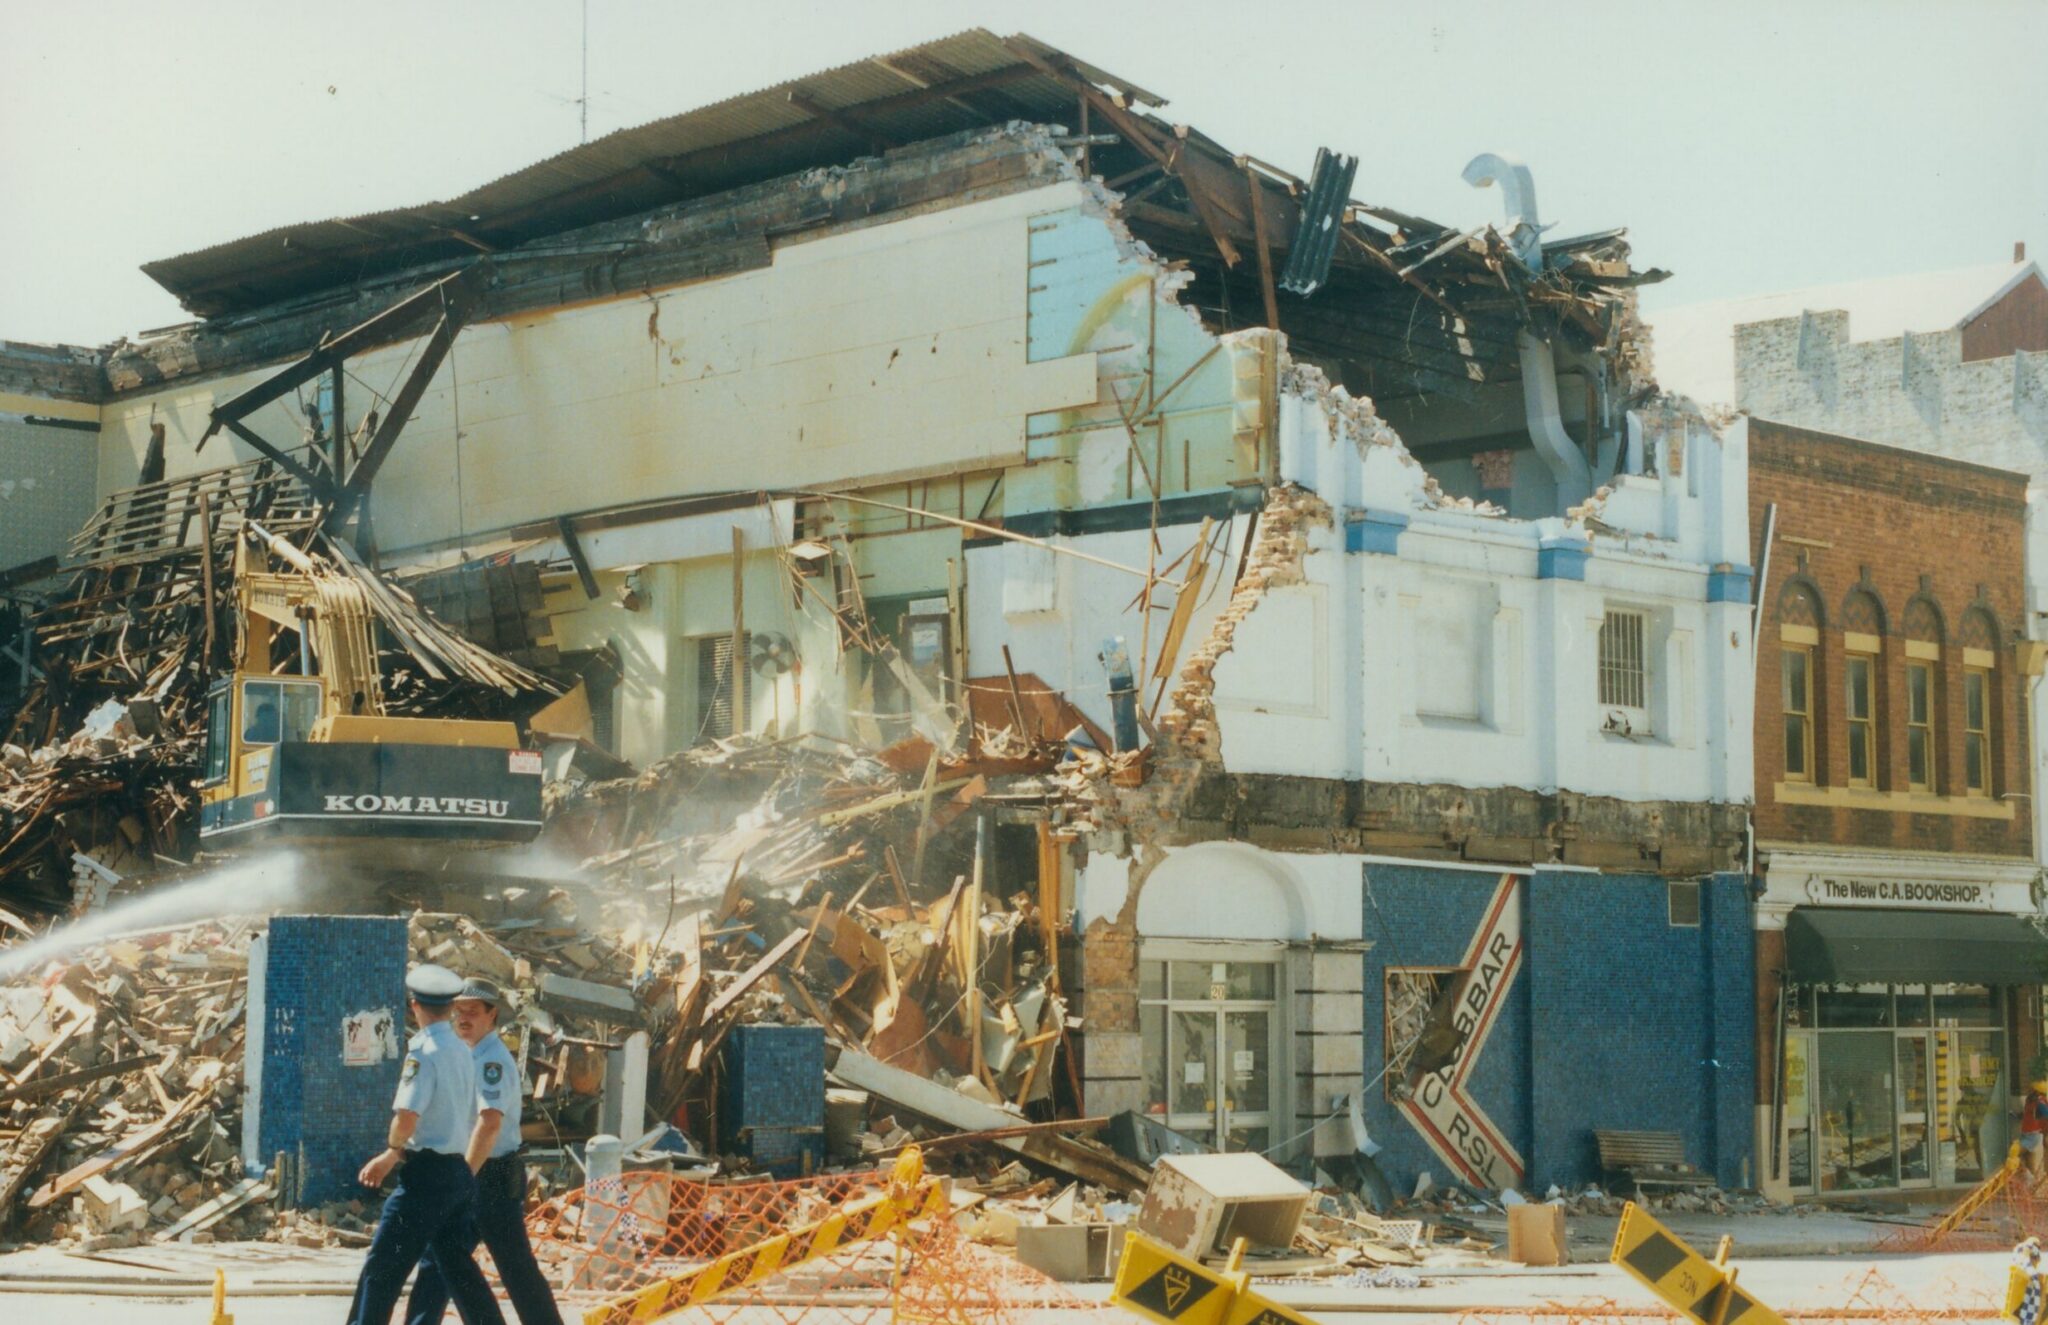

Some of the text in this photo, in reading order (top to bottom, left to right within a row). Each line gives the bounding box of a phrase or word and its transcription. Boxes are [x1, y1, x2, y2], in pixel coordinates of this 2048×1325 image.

[324, 794, 509, 817] KOMATSU
[1824, 879, 1848, 898] The
[1851, 881, 1877, 899] New
